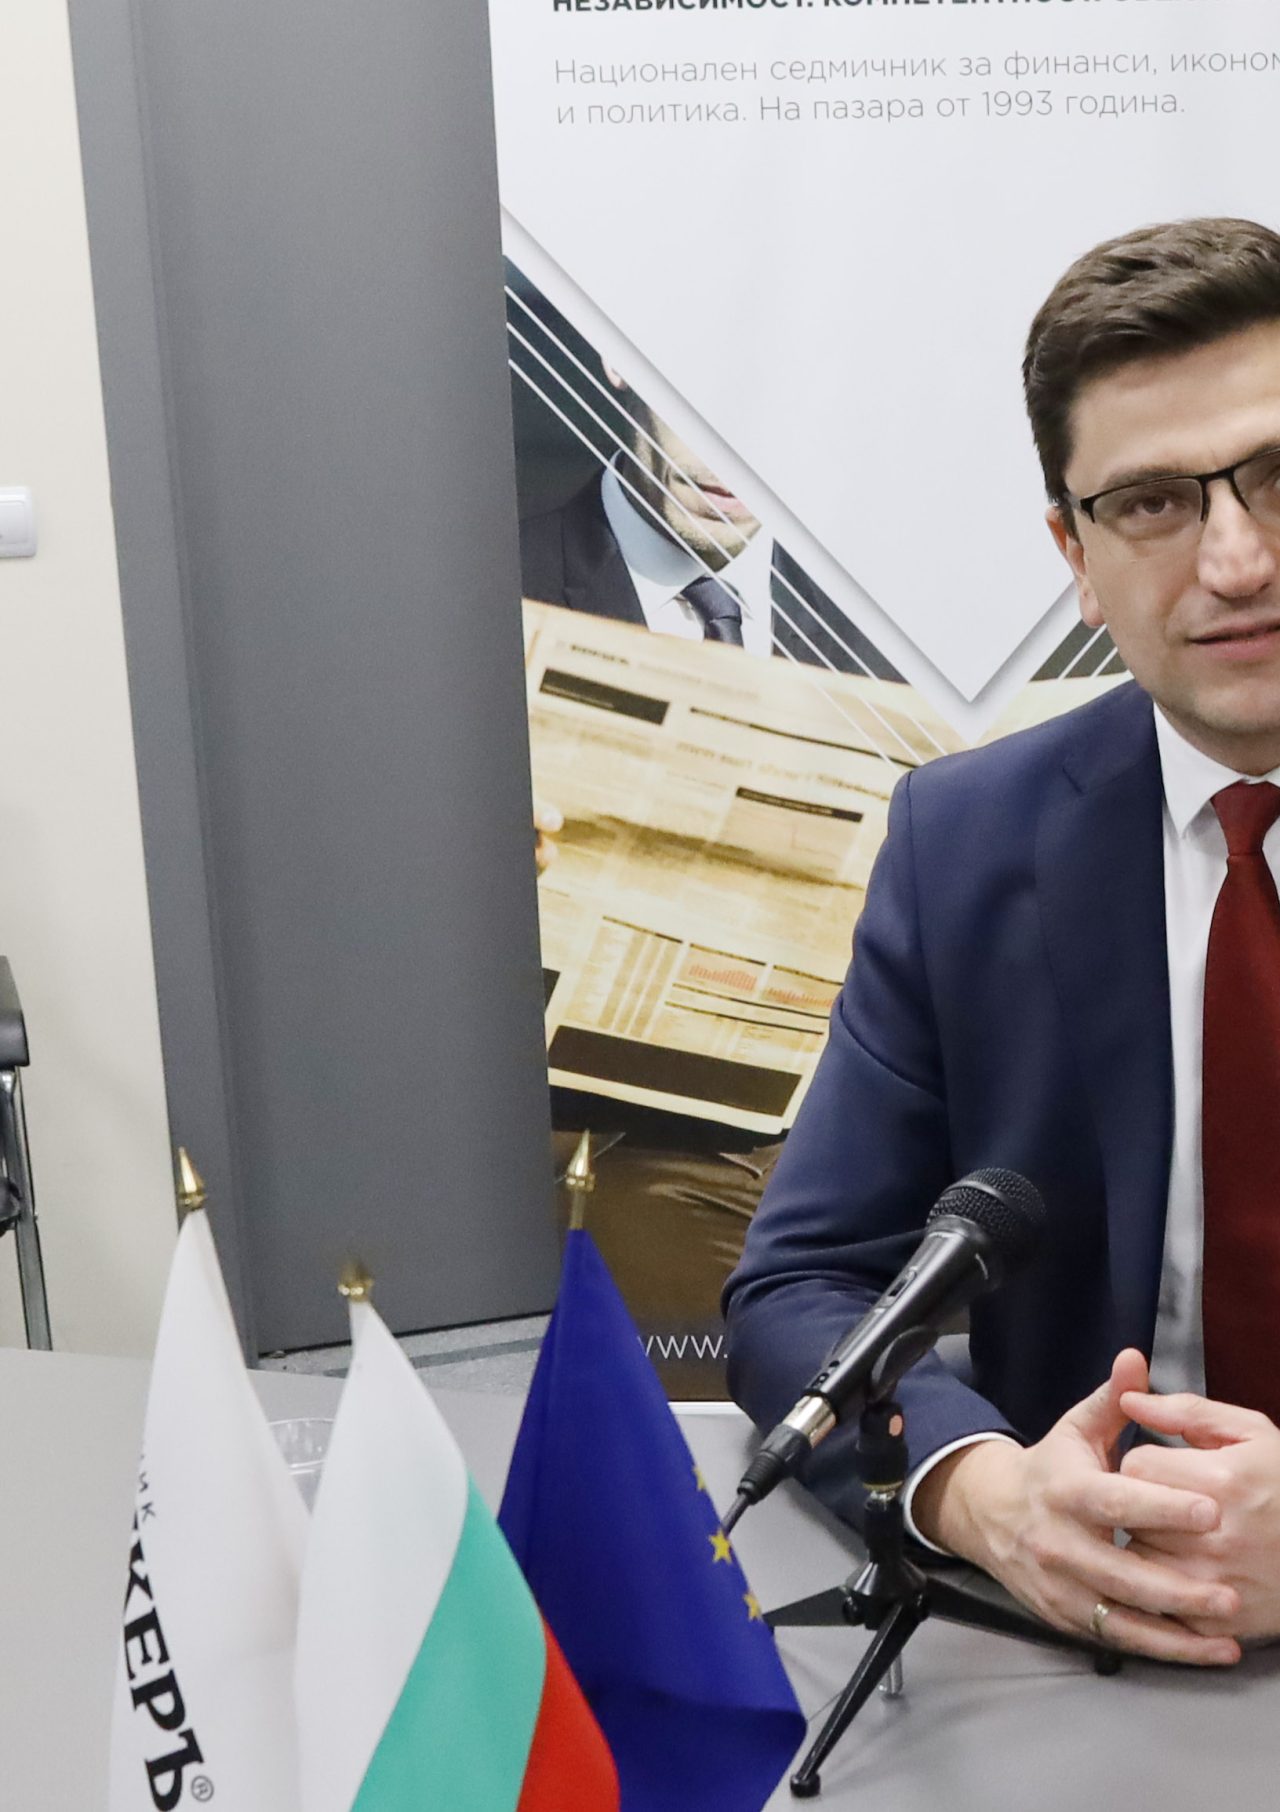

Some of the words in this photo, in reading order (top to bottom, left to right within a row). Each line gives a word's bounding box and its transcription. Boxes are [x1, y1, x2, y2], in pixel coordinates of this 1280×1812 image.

[556, 59, 757, 87] Национален
[770, 57, 946, 84] седмичник
[960, 57, 991, 77] за
[1004, 49, 1157, 81] финанси,
[557, 106, 574, 125] и
[588, 102, 746, 125] политика.
[760, 96, 800, 121] На
[814, 98, 923, 123] пазара
[937, 98, 970, 118] от
[982, 90, 1052, 117] 1993
[1065, 93, 1184, 119] година.
[124, 1510, 205, 1812] КЕРЪ
